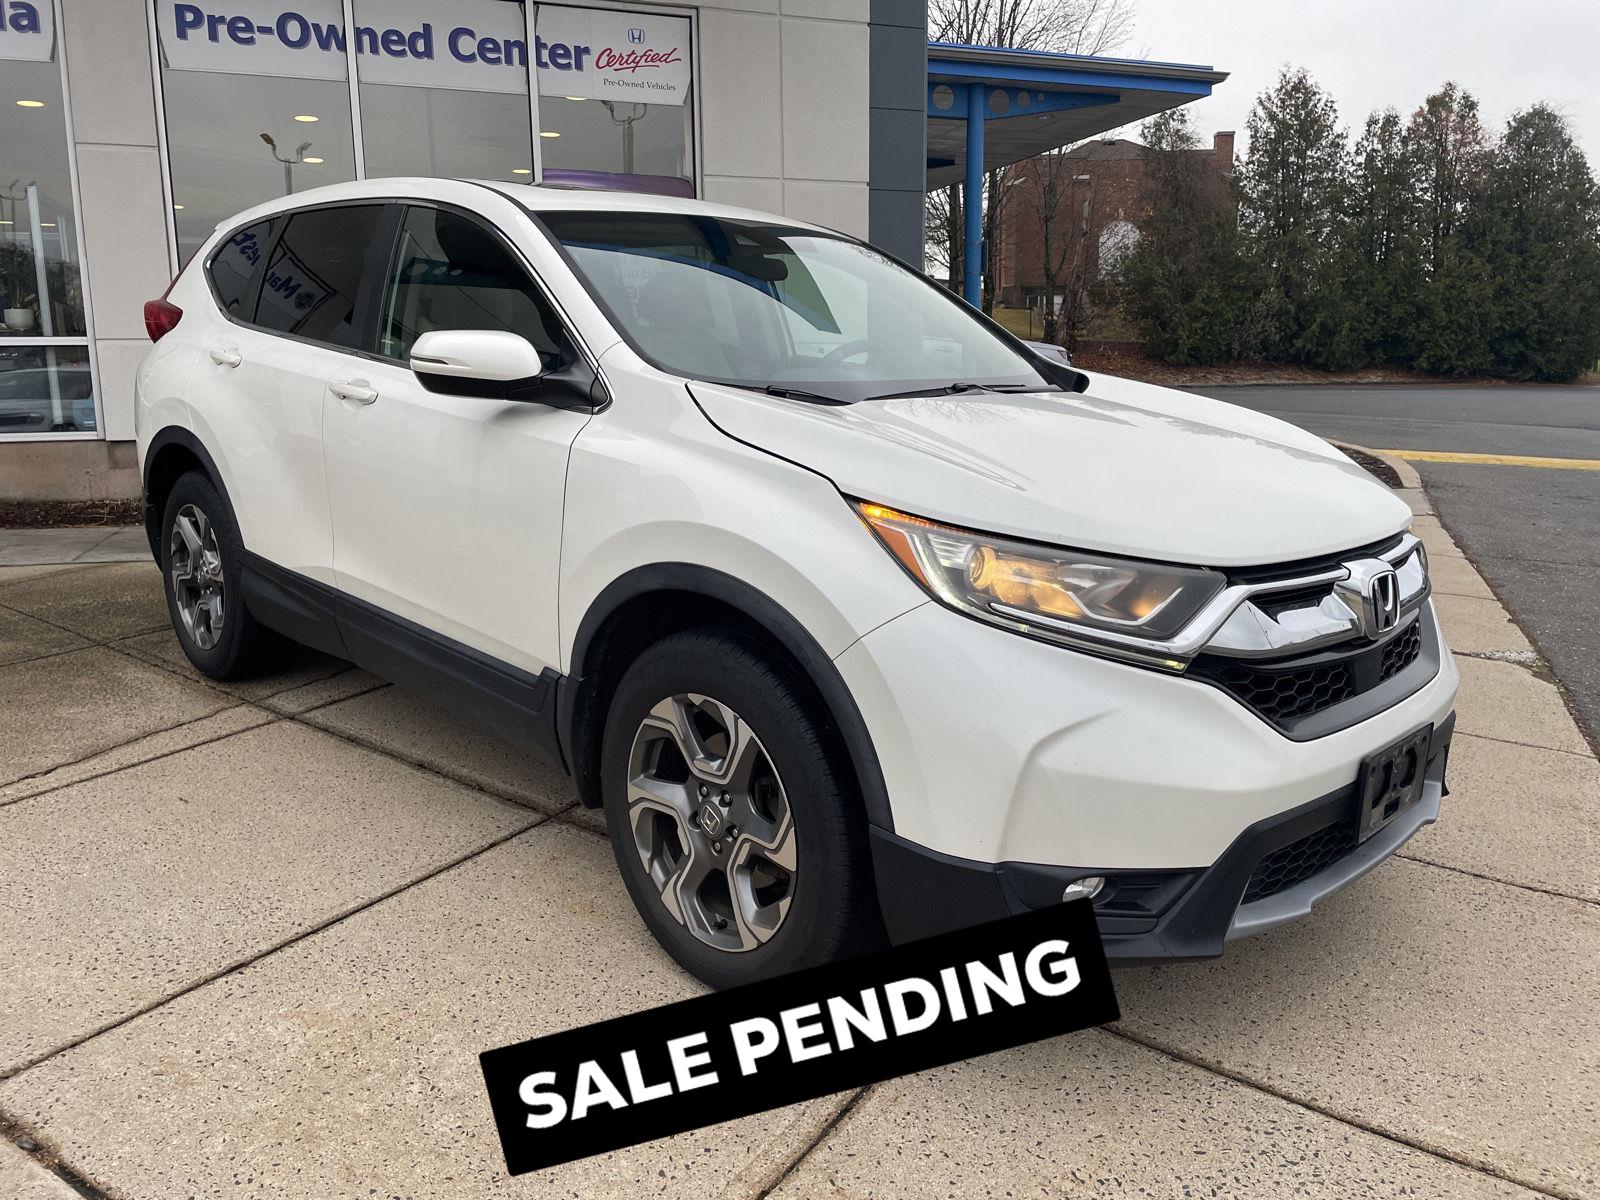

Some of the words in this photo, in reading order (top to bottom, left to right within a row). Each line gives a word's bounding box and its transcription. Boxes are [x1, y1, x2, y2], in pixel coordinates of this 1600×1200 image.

[174, 3, 433, 60] Pre-Owned
[448, 26, 591, 72] Center
[596, 47, 682, 73] Certified
[603, 78, 644, 88] Pre-Owned
[646, 81, 676, 91] Vehicles
